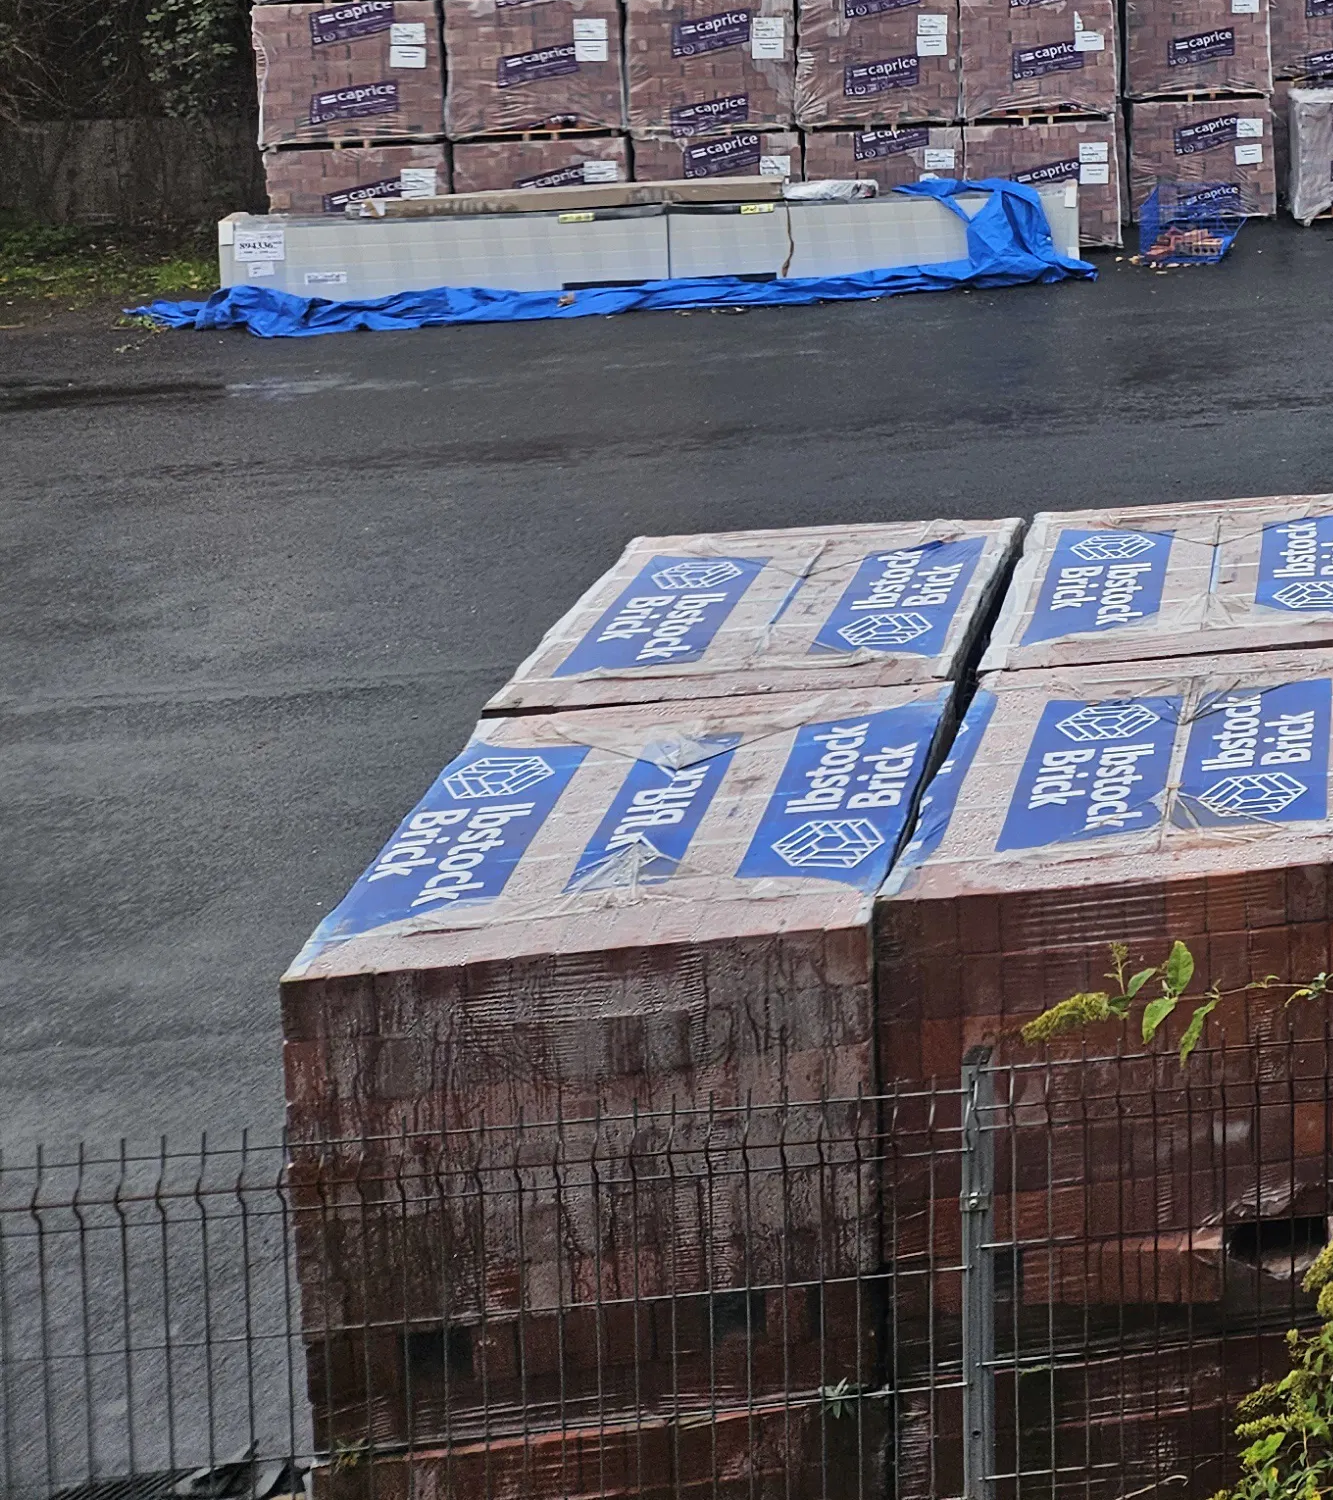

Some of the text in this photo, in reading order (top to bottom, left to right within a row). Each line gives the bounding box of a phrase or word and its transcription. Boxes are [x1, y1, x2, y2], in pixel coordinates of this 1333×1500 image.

[335, 1, 393, 21] caprice
[696, 12, 748, 32] caprice
[522, 45, 576, 63] caprice
[1189, 30, 1233, 50] caprice
[868, 57, 918, 78] caprice
[336, 83, 396, 104] caprice
[694, 97, 747, 115] caprice
[706, 134, 758, 155] caprice
[1195, 116, 1237, 136] caprice
[349, 179, 402, 200] caprice
[1032, 161, 1080, 181] caprice
[1197, 186, 1239, 203] caprice
[1273, 521, 1317, 578] Ibstock
[850, 548, 923, 611] Ibstock
[902, 563, 963, 608] Brick
[1050, 566, 1104, 611] Brick
[1095, 563, 1152, 626] Ibstock
[597, 596, 656, 642] Brick
[637, 592, 727, 661] Ibstock
[1202, 694, 1262, 771] Ibstock
[1260, 710, 1315, 765] Brick
[785, 722, 870, 814] Ibstock
[847, 742, 918, 810] Brick
[1027, 748, 1096, 810] Brick
[1085, 743, 1155, 830] Ibstock
[368, 808, 471, 883] Brick
[411, 801, 536, 907] Ibstock
